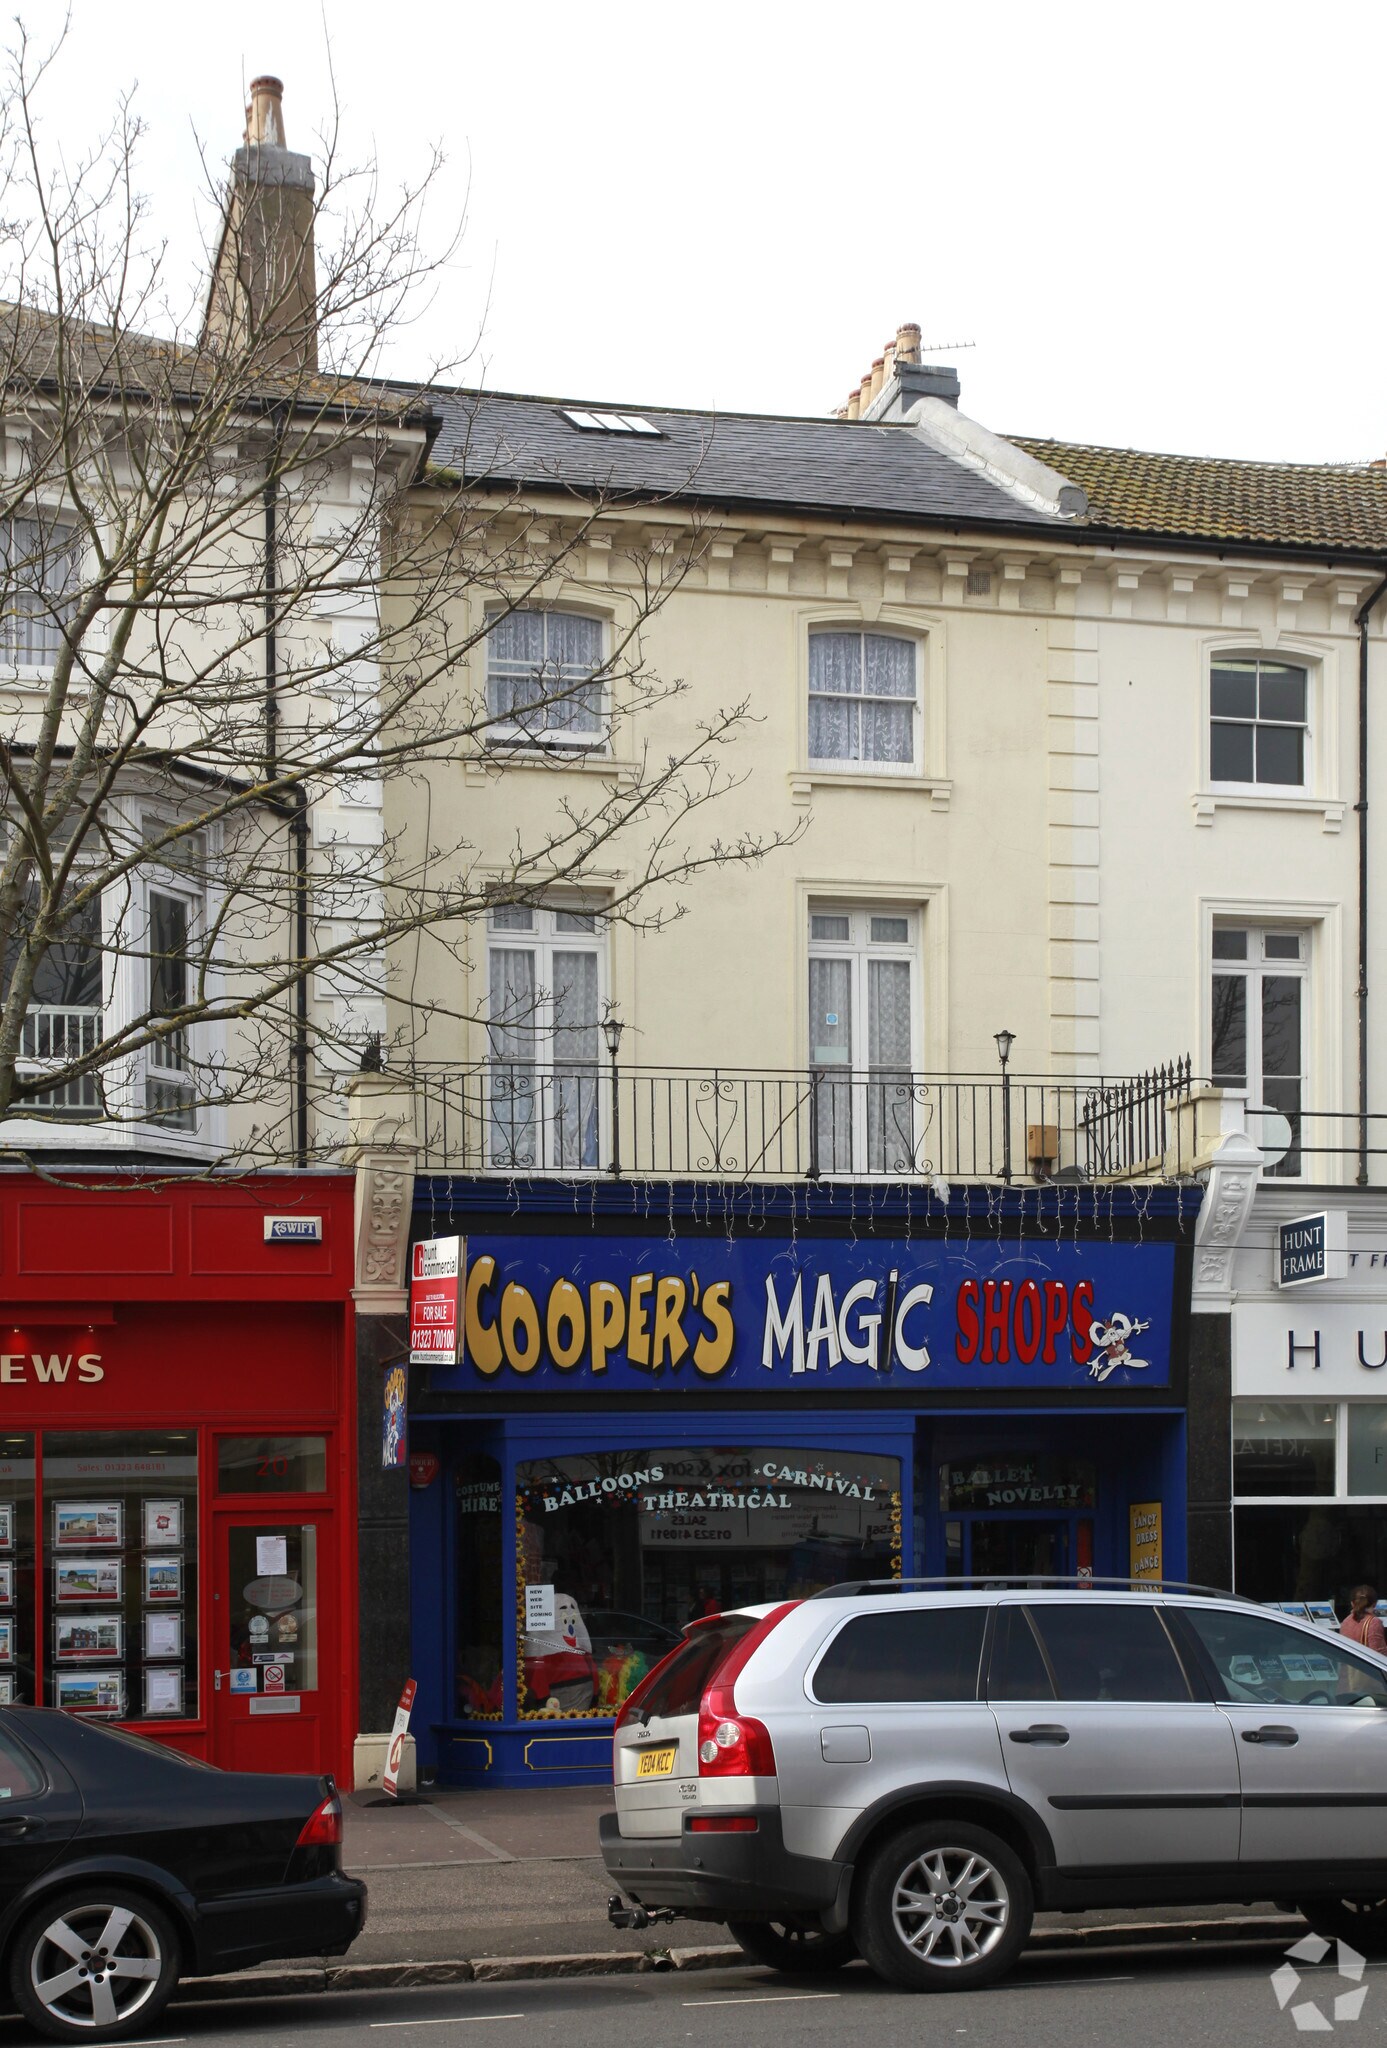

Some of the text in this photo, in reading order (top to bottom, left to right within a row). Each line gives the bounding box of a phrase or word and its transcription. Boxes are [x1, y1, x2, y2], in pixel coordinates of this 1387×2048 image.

[280, 1222, 315, 1234] SWIFT
[1284, 1226, 1322, 1251] HUNT
[424, 1244, 437, 1260] hunt
[424, 1256, 457, 1276] commercial
[1283, 1251, 1323, 1276] FRAME
[423, 1305, 447, 1321] FOR SALE
[465, 1255, 735, 1376] COOPER'S
[954, 1277, 1095, 1366] SHOPS
[411, 1329, 455, 1348] 01323 700100
[0, 1354, 105, 1383] EWS
[77, 1463, 100, 1472] Sales:
[256, 1455, 289, 1477] 20
[952, 1466, 1035, 1486] BALLET
[455, 1482, 501, 1497] COSTUME
[542, 1466, 665, 1513] BALLOONS
[762, 1463, 877, 1502] CARNIVAL
[461, 1496, 498, 1513] HIRE
[643, 1491, 792, 1512] THEATRICAL
[986, 1484, 1082, 1506] NOVELTY
[1134, 1513, 1157, 1530] FANCY
[1136, 1530, 1159, 1545] DRESS
[1134, 1556, 1159, 1573] DANCE
[640, 1752, 671, 1774] YE04 KCC
